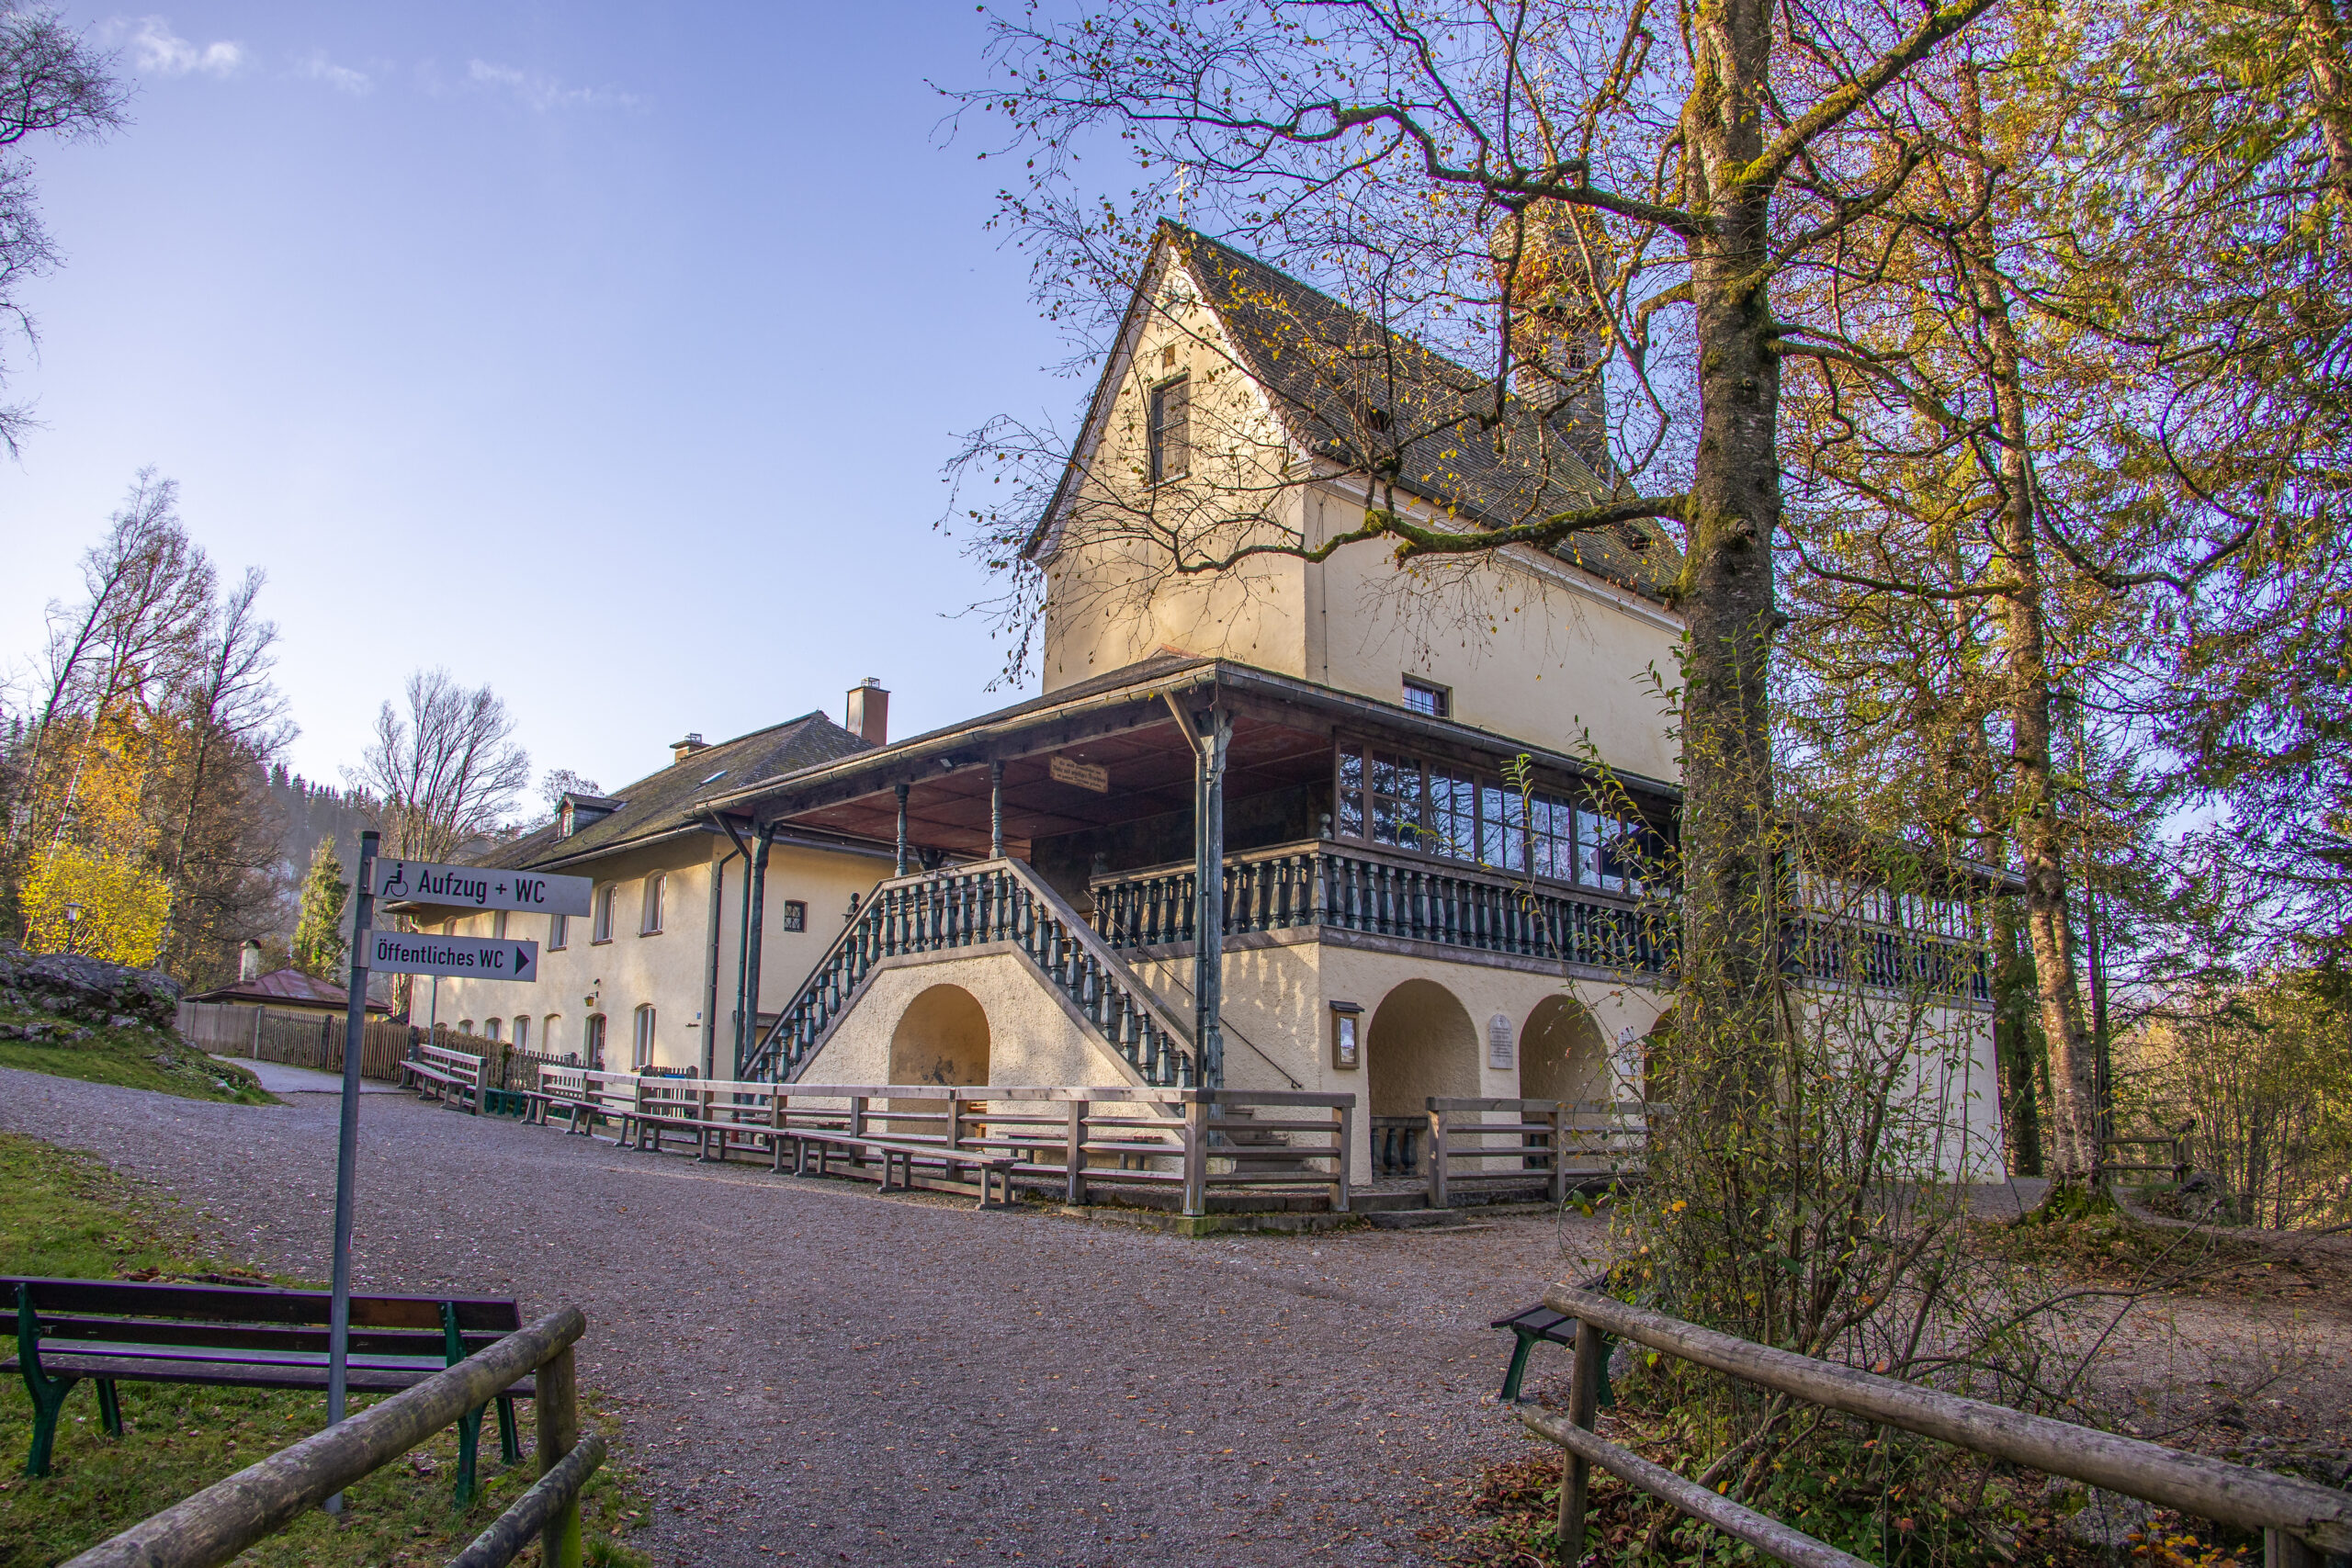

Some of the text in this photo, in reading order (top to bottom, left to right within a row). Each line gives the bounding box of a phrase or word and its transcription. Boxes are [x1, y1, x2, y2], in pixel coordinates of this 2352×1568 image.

[418, 869, 546, 905] Aufzug + WC
[378, 938, 503, 968] Öffentliches WC
